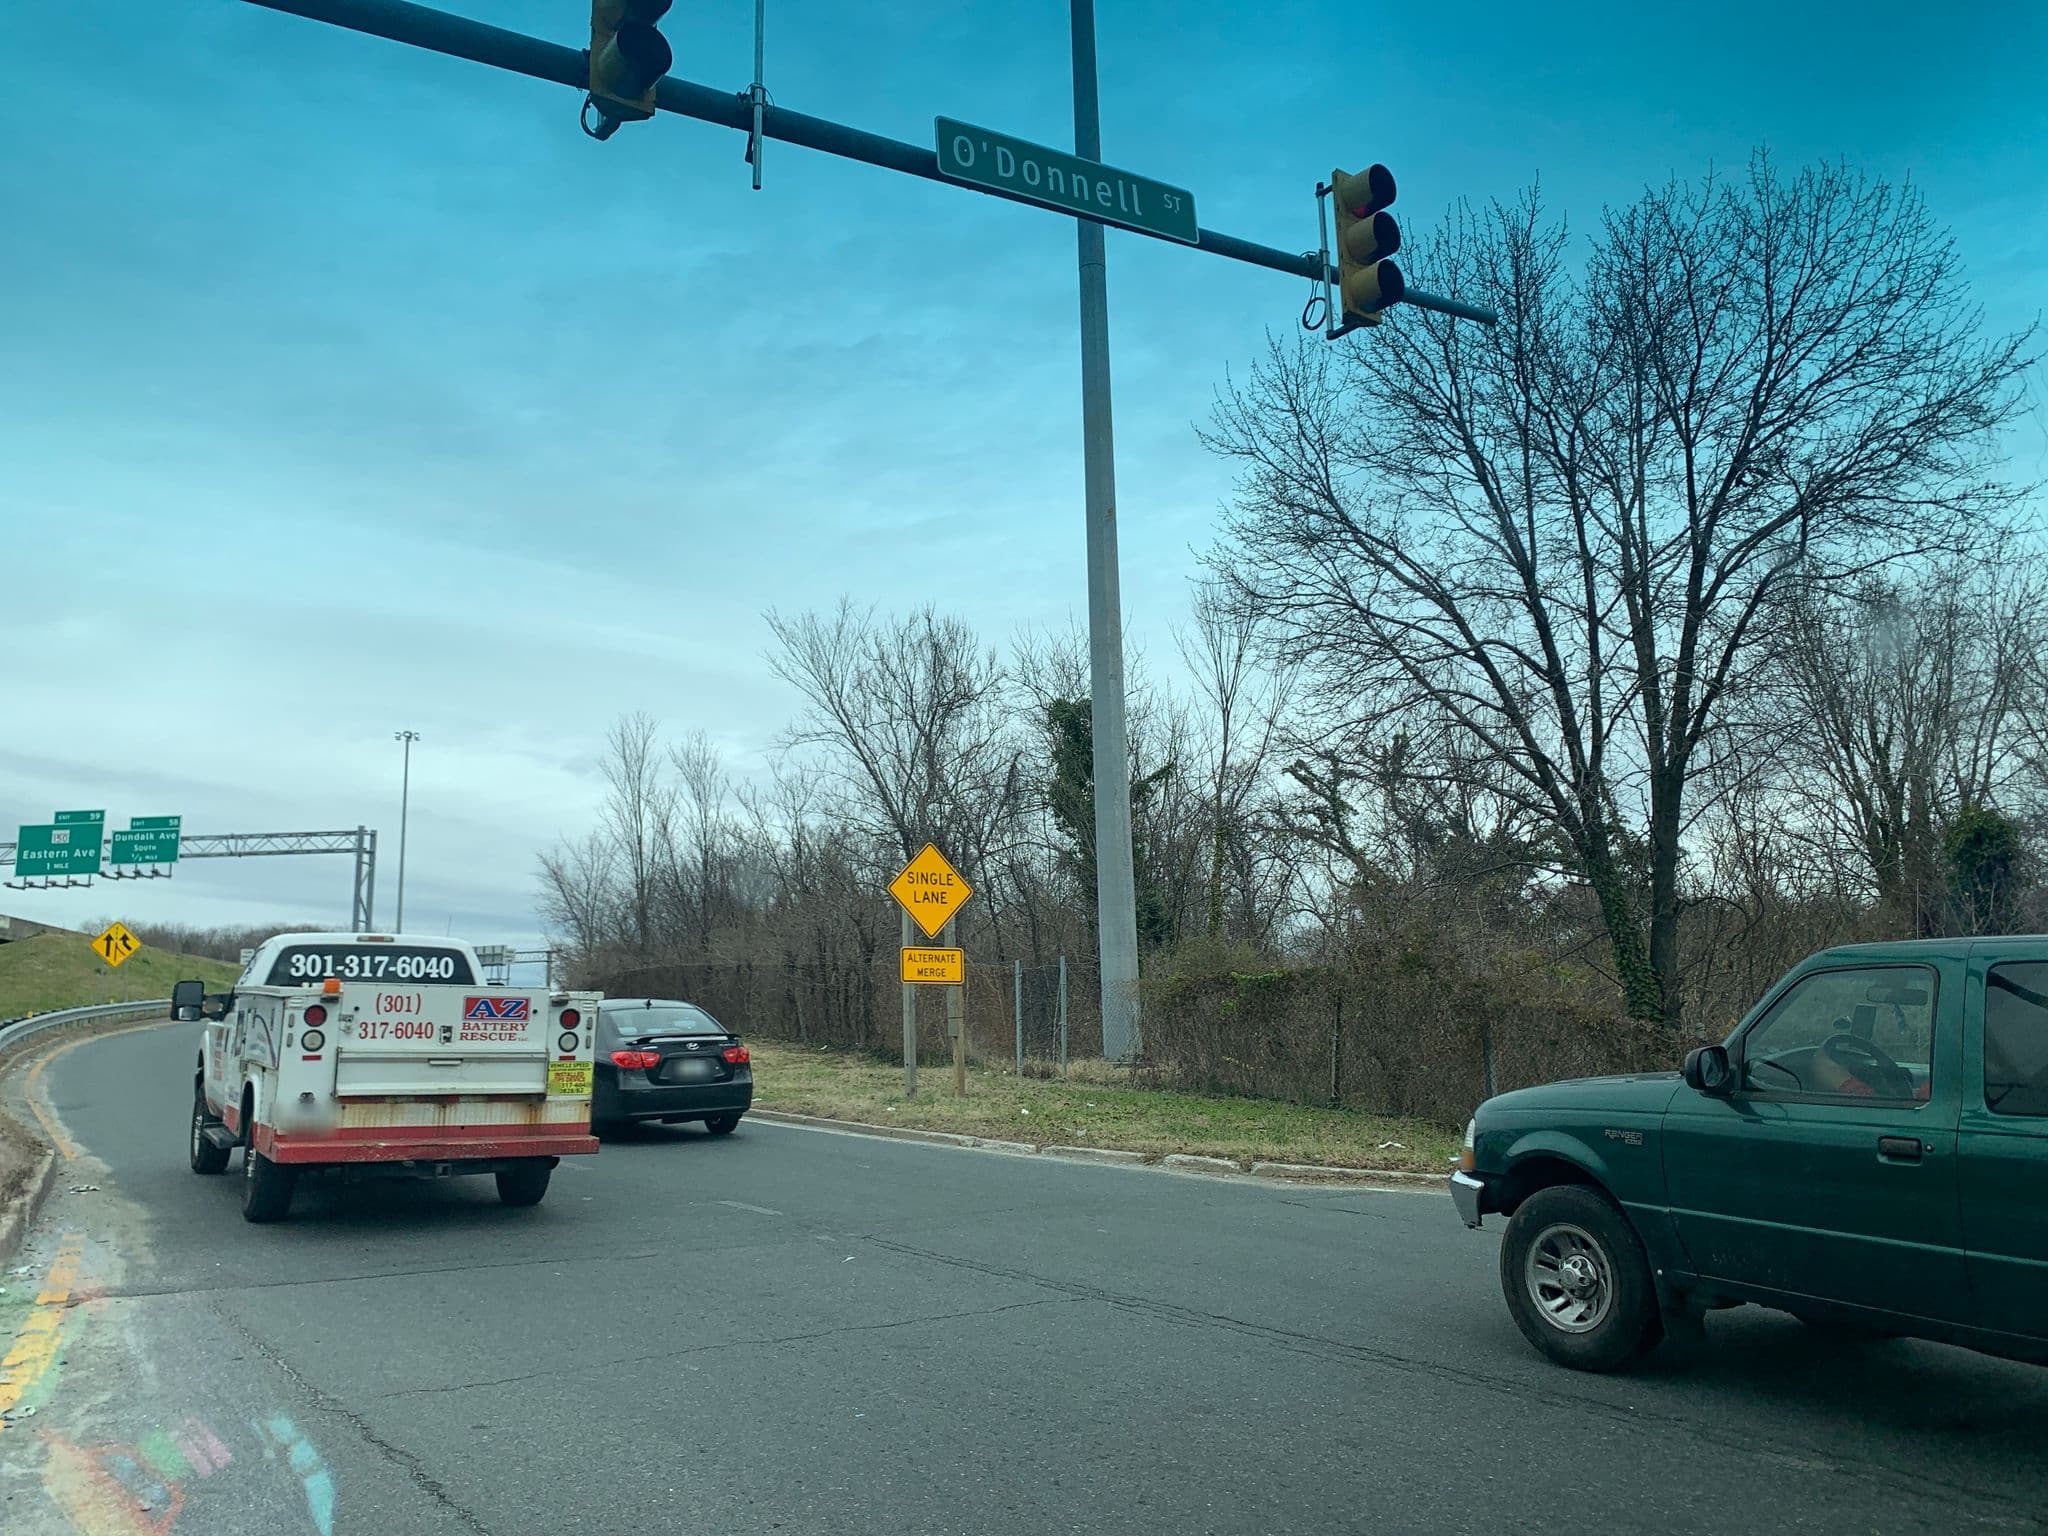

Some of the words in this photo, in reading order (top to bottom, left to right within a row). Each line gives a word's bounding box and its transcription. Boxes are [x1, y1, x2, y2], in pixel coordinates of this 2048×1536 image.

[952, 135, 1142, 217] O'Donnell
[1163, 193, 1181, 213] ST
[115, 832, 154, 841] Dundalk
[160, 832, 176, 840] Ave
[23, 849, 68, 859] Eastern
[74, 849, 95, 857] Ave
[907, 871, 954, 886] SINGLE
[914, 890, 948, 904] LANE
[907, 953, 956, 964] ALTERNATE
[290, 954, 454, 978] 301-317-6040
[917, 967, 946, 977] MERGE
[376, 993, 421, 1015] (301)
[466, 999, 527, 1019] AZ
[359, 1021, 434, 1040] 317-6040
[462, 1022, 528, 1032] BATTERY
[459, 1032, 517, 1041] RESCUE
